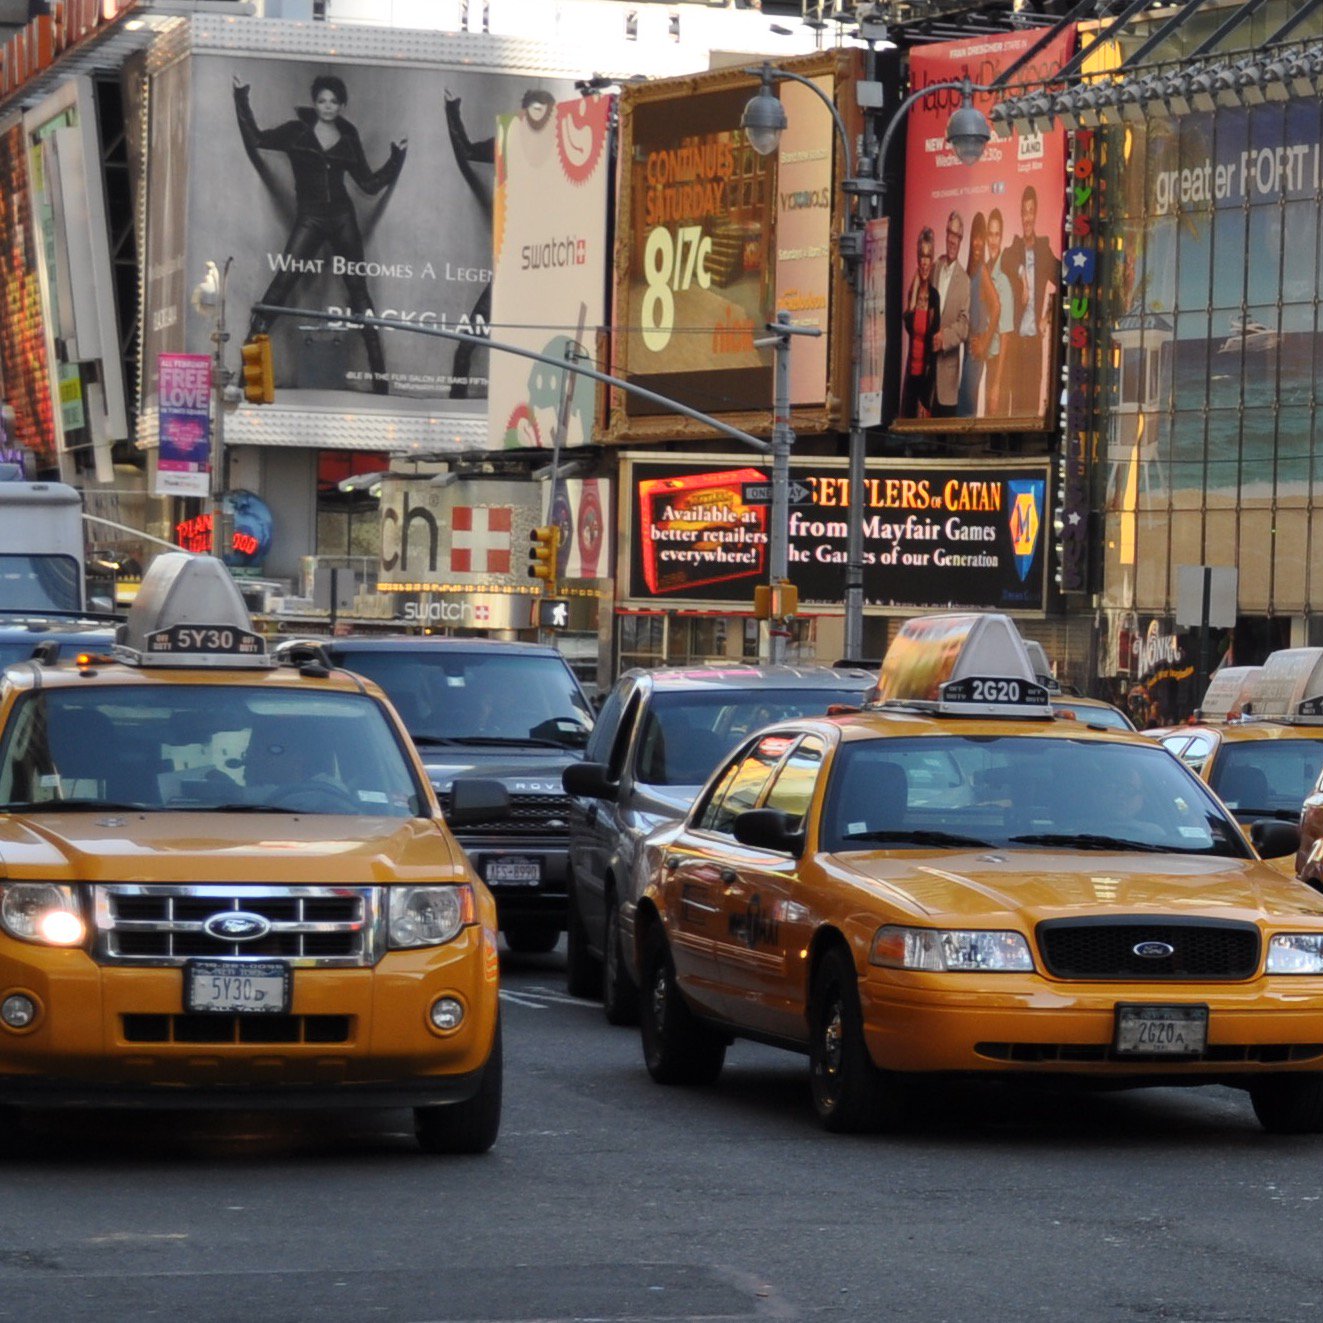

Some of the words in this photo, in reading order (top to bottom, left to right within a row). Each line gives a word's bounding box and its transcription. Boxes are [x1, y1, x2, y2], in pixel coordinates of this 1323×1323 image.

[925, 138, 944, 153] NEW
[1021, 141, 1041, 155] LAND
[647, 142, 734, 186] CONTINUES
[1156, 159, 1236, 216] greater
[1240, 144, 1309, 196] FORT
[647, 181, 724, 224] SATURDAY
[521, 236, 575, 270] swatch
[421, 262, 436, 280] A
[327, 306, 491, 336] BLACKGLAM
[160, 368, 208, 389] FREE
[160, 387, 208, 409] LOVE
[789, 488, 802, 497] AY
[807, 477, 930, 508] SETLERS
[945, 479, 1002, 511] CATAN
[662, 506, 737, 522] Available
[741, 511, 757, 523] at
[382, 491, 438, 572] ch
[651, 525, 699, 542] better
[703, 527, 768, 544] retailers
[788, 512, 848, 537] from
[861, 516, 941, 545] Mayfair
[945, 517, 997, 542] Games
[660, 547, 757, 567] everywhere!
[788, 544, 811, 563] he
[816, 545, 876, 565] Gaes
[881, 545, 901, 565] of
[902, 552, 929, 567] our
[933, 548, 999, 568] Generation
[404, 600, 472, 620] swatch
[178, 629, 233, 648] 5Y30
[972, 680, 1020, 701] 2G20
[516, 782, 564, 790] ROV
[1143, 945, 1163, 954] Ford
[212, 977, 265, 1001] 5Y30D
[1139, 1022, 1184, 1044] 2G20A
